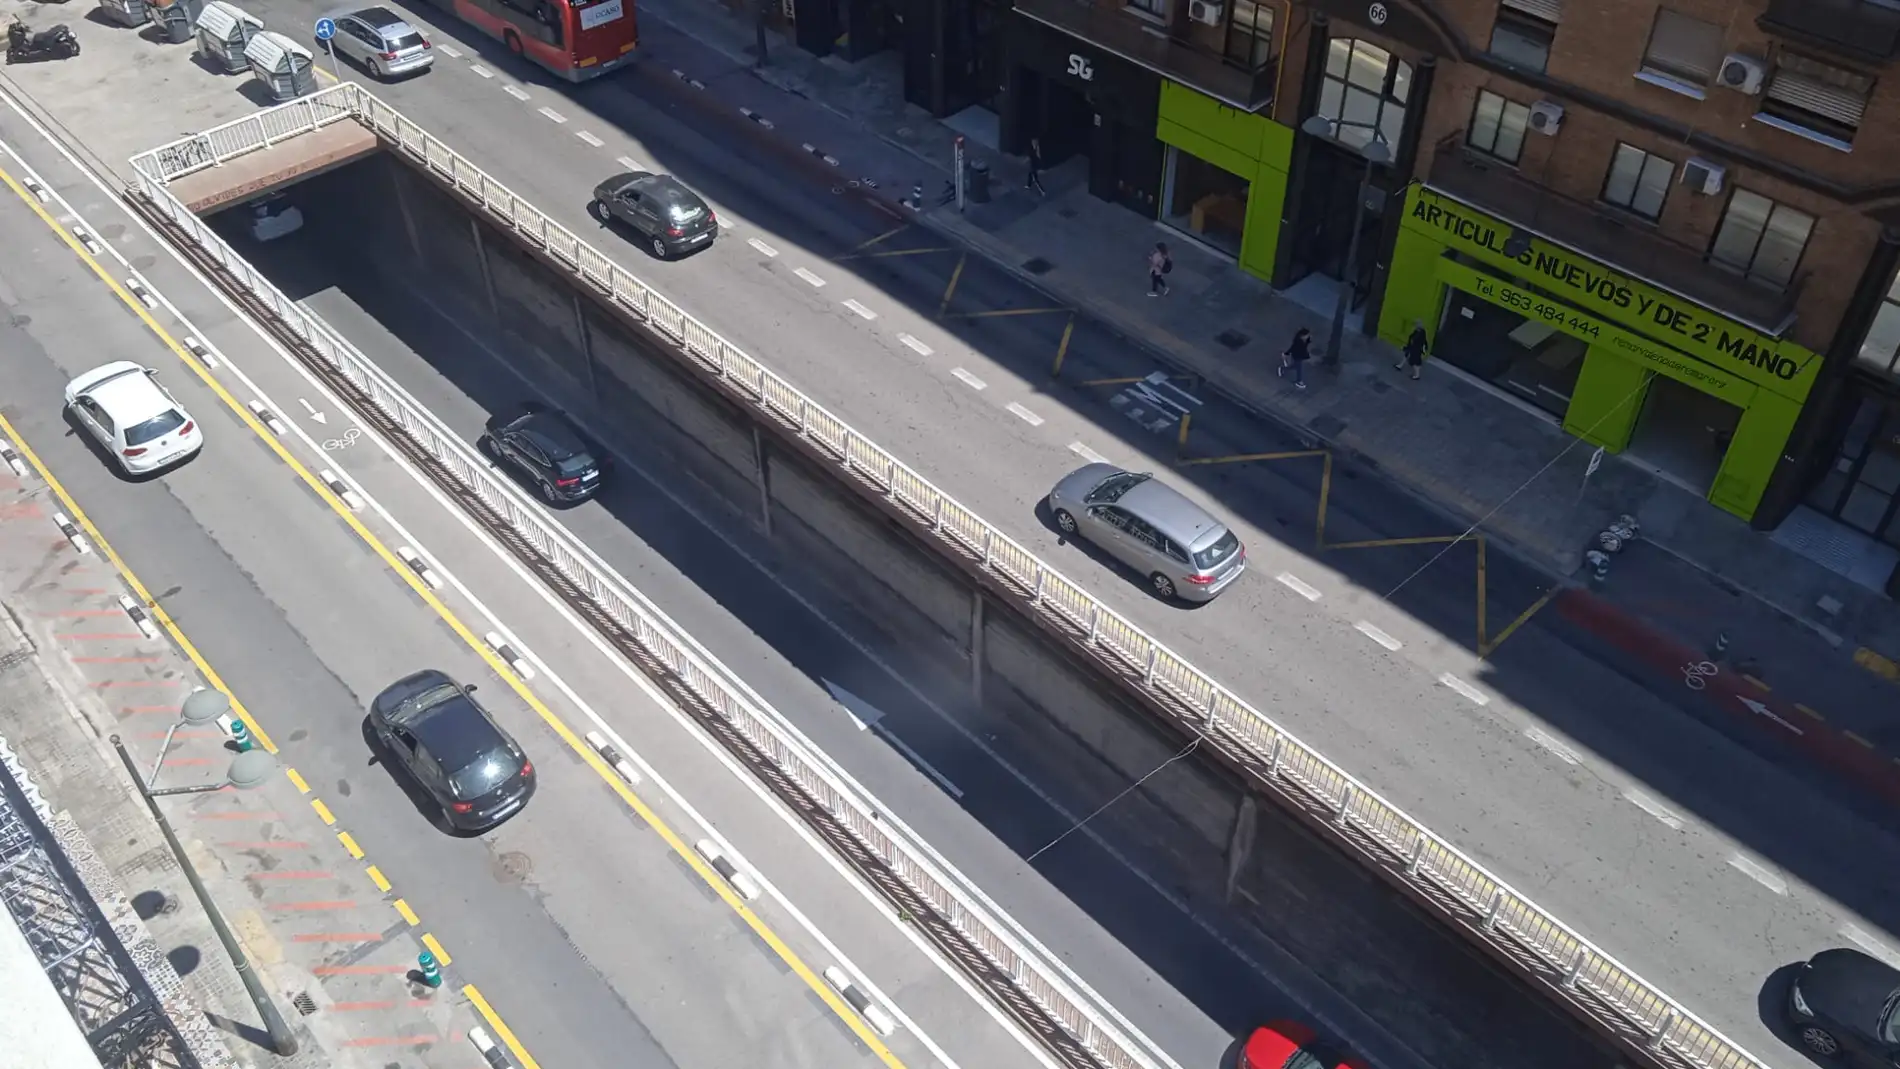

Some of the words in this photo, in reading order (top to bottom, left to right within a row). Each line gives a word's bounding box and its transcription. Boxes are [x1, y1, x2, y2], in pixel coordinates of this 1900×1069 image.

[1370, 5, 1386, 21] 66
[1500, 288, 1533, 311] 963
[1534, 303, 1566, 325] 484
[1568, 317, 1600, 339] 444
[1534, 252, 1633, 308] NUEVOS
[1638, 293, 1655, 316] Y
[1653, 303, 1693, 335] DE
[1716, 330, 1798, 381] MANO
